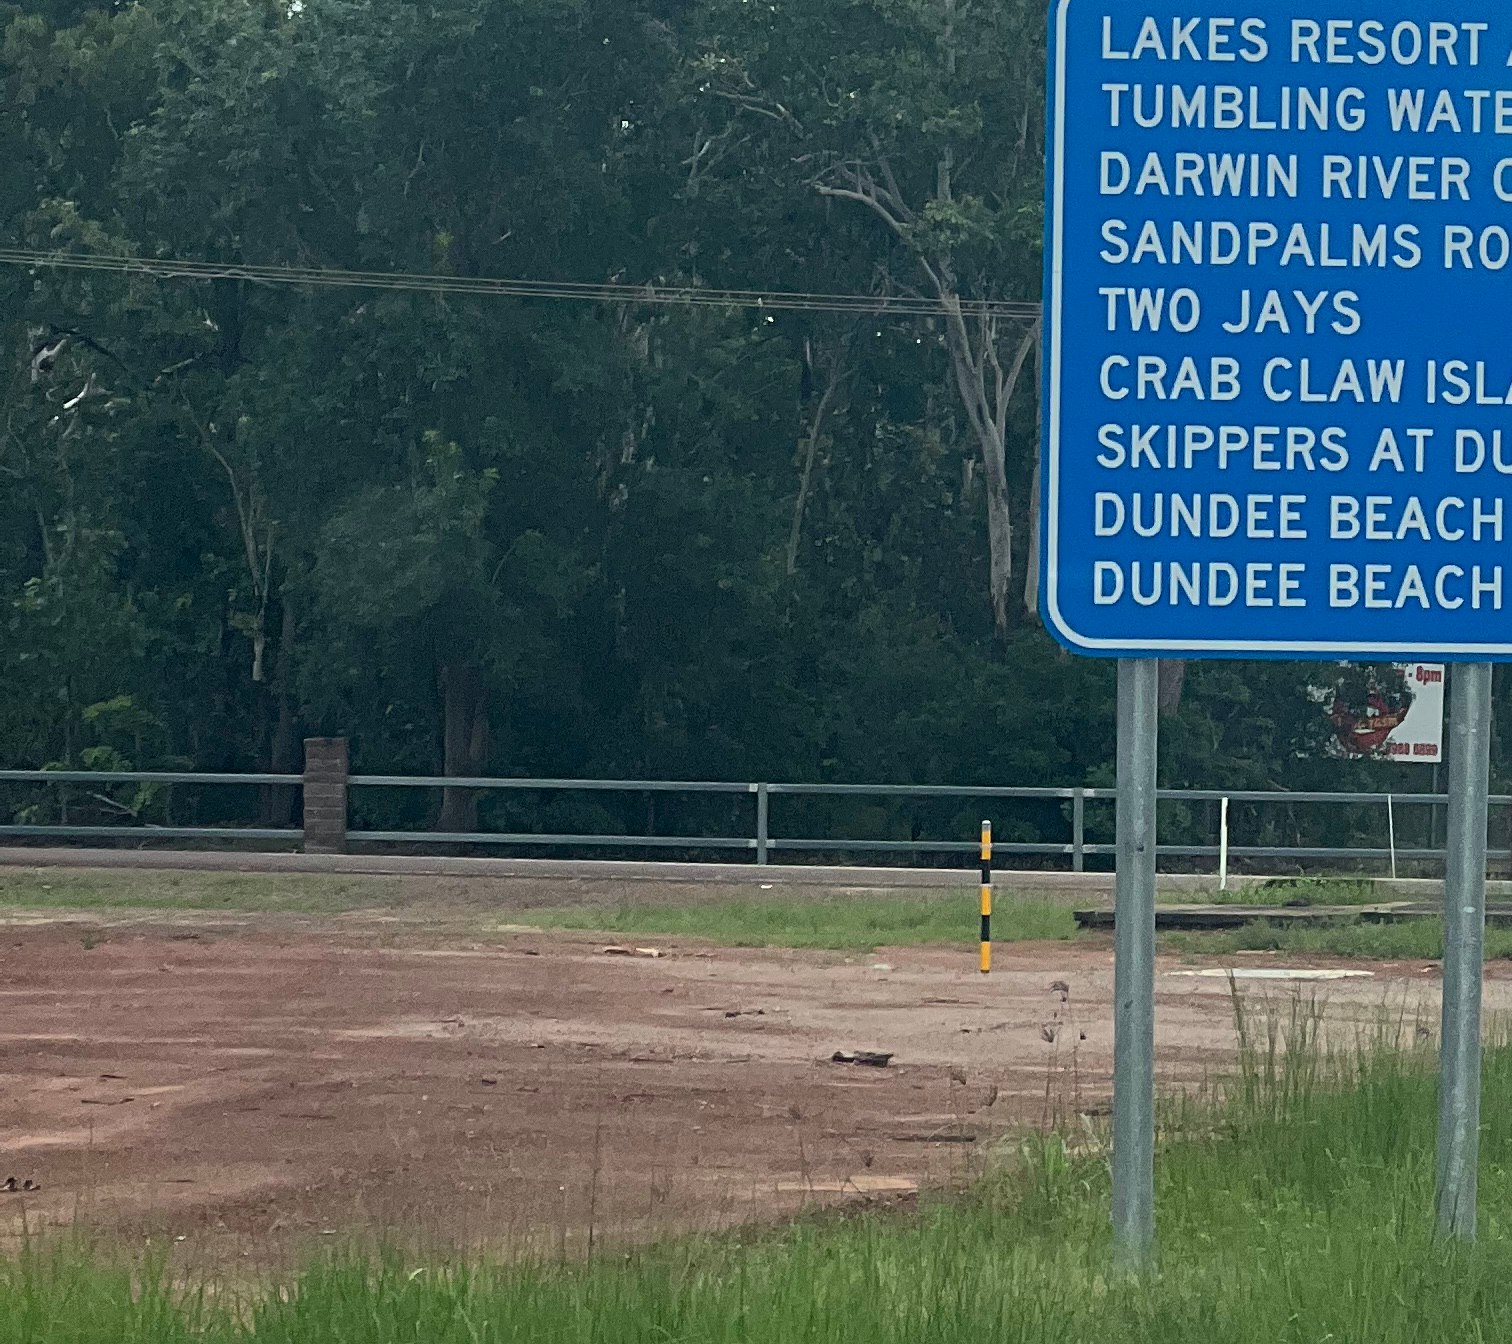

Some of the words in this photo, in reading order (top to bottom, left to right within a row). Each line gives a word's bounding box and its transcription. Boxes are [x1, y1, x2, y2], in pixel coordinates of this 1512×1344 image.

[1102, 15, 1268, 62] LAKES
[1291, 19, 1488, 66] RESORT
[1101, 83, 1365, 132] TUMBLING
[1100, 151, 1297, 198] DARWIN
[1323, 155, 1470, 201] RIVER
[1099, 219, 1421, 269] SANDPALMS
[1098, 287, 1200, 333] TWO
[1222, 289, 1361, 335] JAYS
[1099, 354, 1241, 401] CRAB
[1263, 357, 1405, 403] CLAW
[1096, 423, 1349, 471] SKIPPERS
[1369, 427, 1434, 472] AT
[1095, 492, 1307, 539] DUNDEE
[1330, 495, 1503, 542] BEACH
[1093, 561, 1307, 607] DUNDEE
[1329, 563, 1502, 610] BEACH
